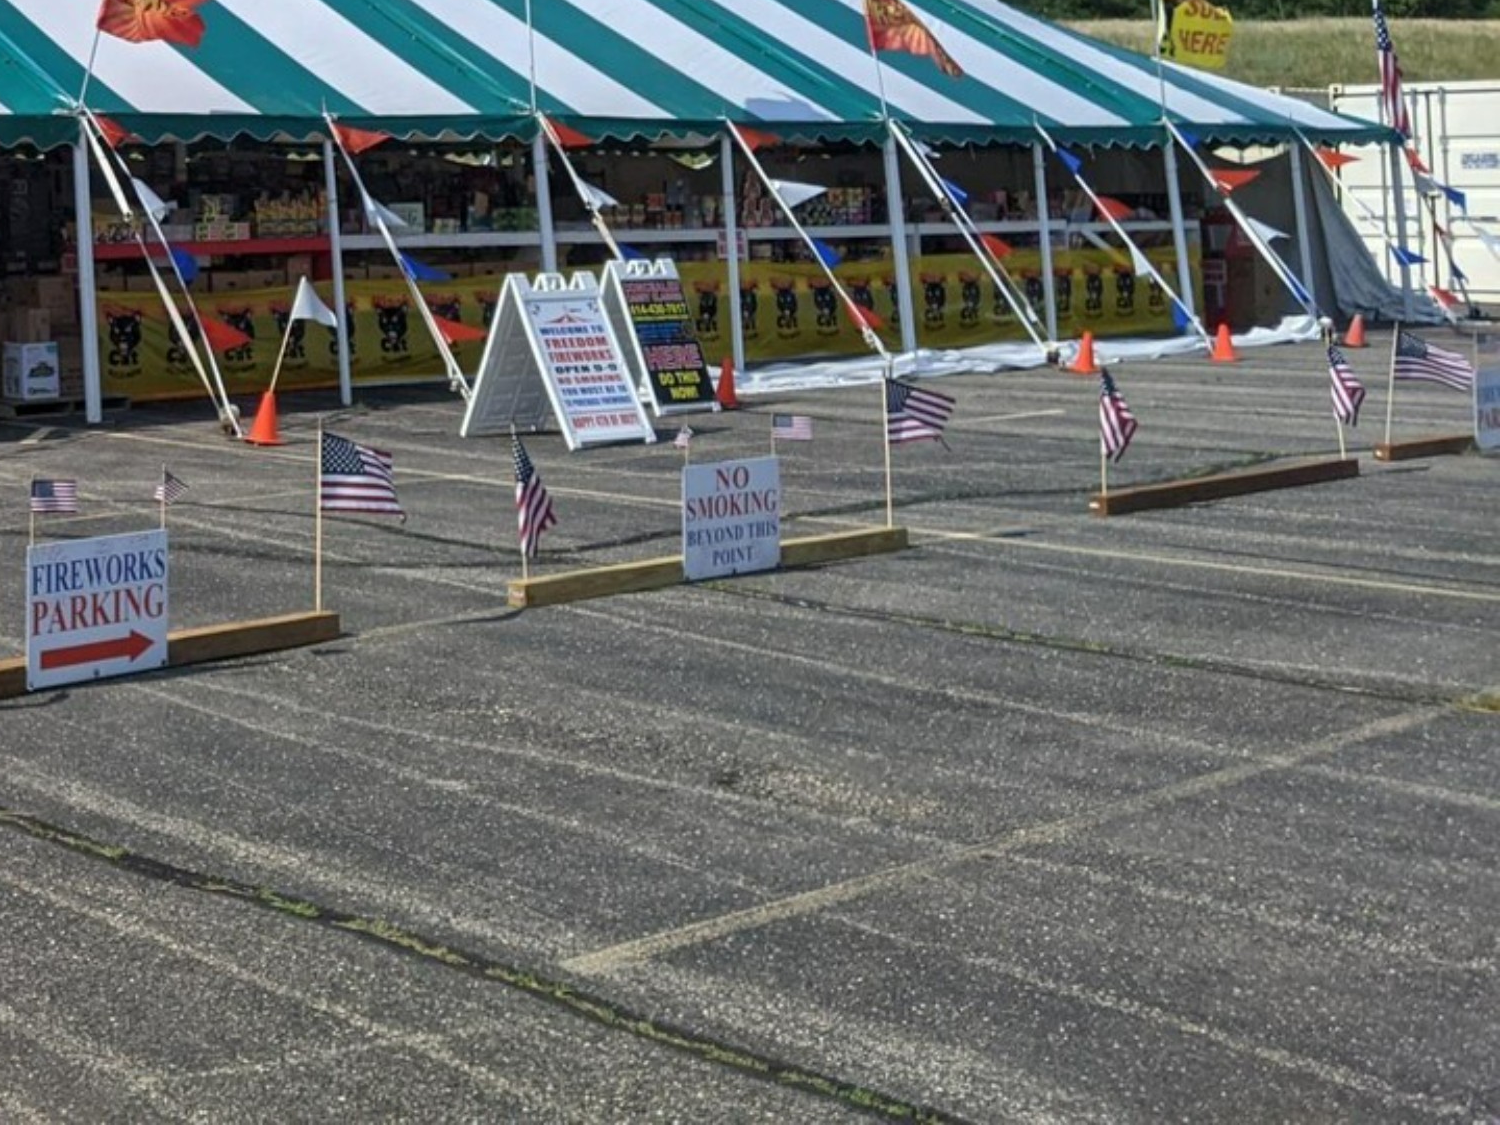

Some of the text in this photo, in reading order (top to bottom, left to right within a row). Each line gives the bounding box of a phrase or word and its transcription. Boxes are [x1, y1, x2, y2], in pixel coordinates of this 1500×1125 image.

[1179, 28, 1230, 55] HERE
[544, 336, 609, 349] FREEDOM
[109, 349, 139, 365] Cat
[548, 349, 615, 363] FIREWORKS
[555, 365, 590, 374] OPEN
[716, 466, 749, 491] NO
[686, 489, 777, 522] SMOKING
[687, 520, 778, 547] BEYOND THIS
[712, 545, 753, 567] POINT
[32, 548, 166, 597] FIREWORKS
[31, 583, 165, 637] PARKING
